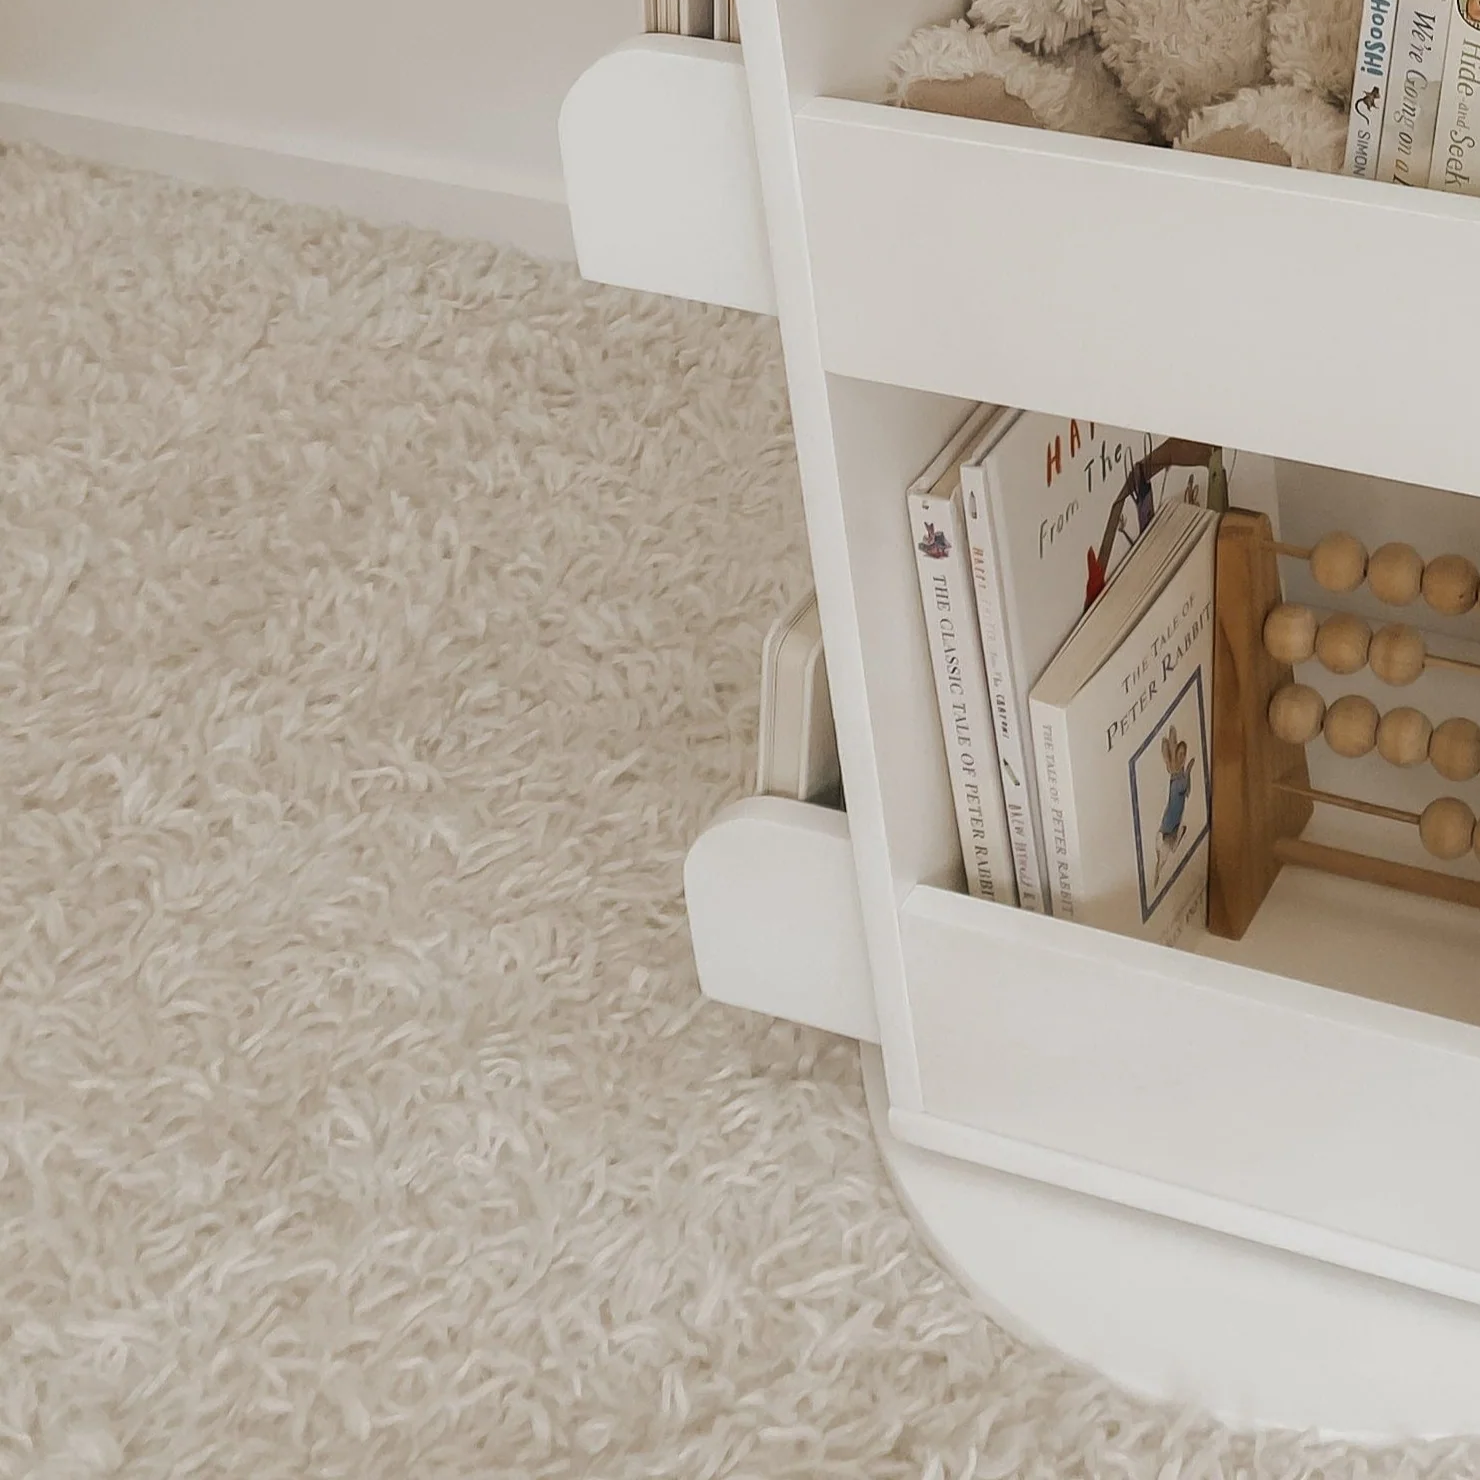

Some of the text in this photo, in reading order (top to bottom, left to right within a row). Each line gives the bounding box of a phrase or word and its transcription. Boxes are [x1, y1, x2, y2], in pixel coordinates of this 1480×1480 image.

[1409, 10, 1436, 63] We're
[1394, 69, 1428, 132] Going
[1353, 130, 1370, 176] SIMON
[1394, 158, 1409, 173] a
[1398, 131, 1413, 156] on
[1084, 440, 1122, 493] The
[1040, 499, 1080, 559] From
[1121, 592, 1196, 695] THE TALE OF
[1106, 602, 1213, 752] PETER RABBIT
[933, 574, 985, 840] THE CLASSIC TALE OF PETER
[1051, 807, 1067, 856] PETER
[1057, 860, 1074, 917] RABBIT
